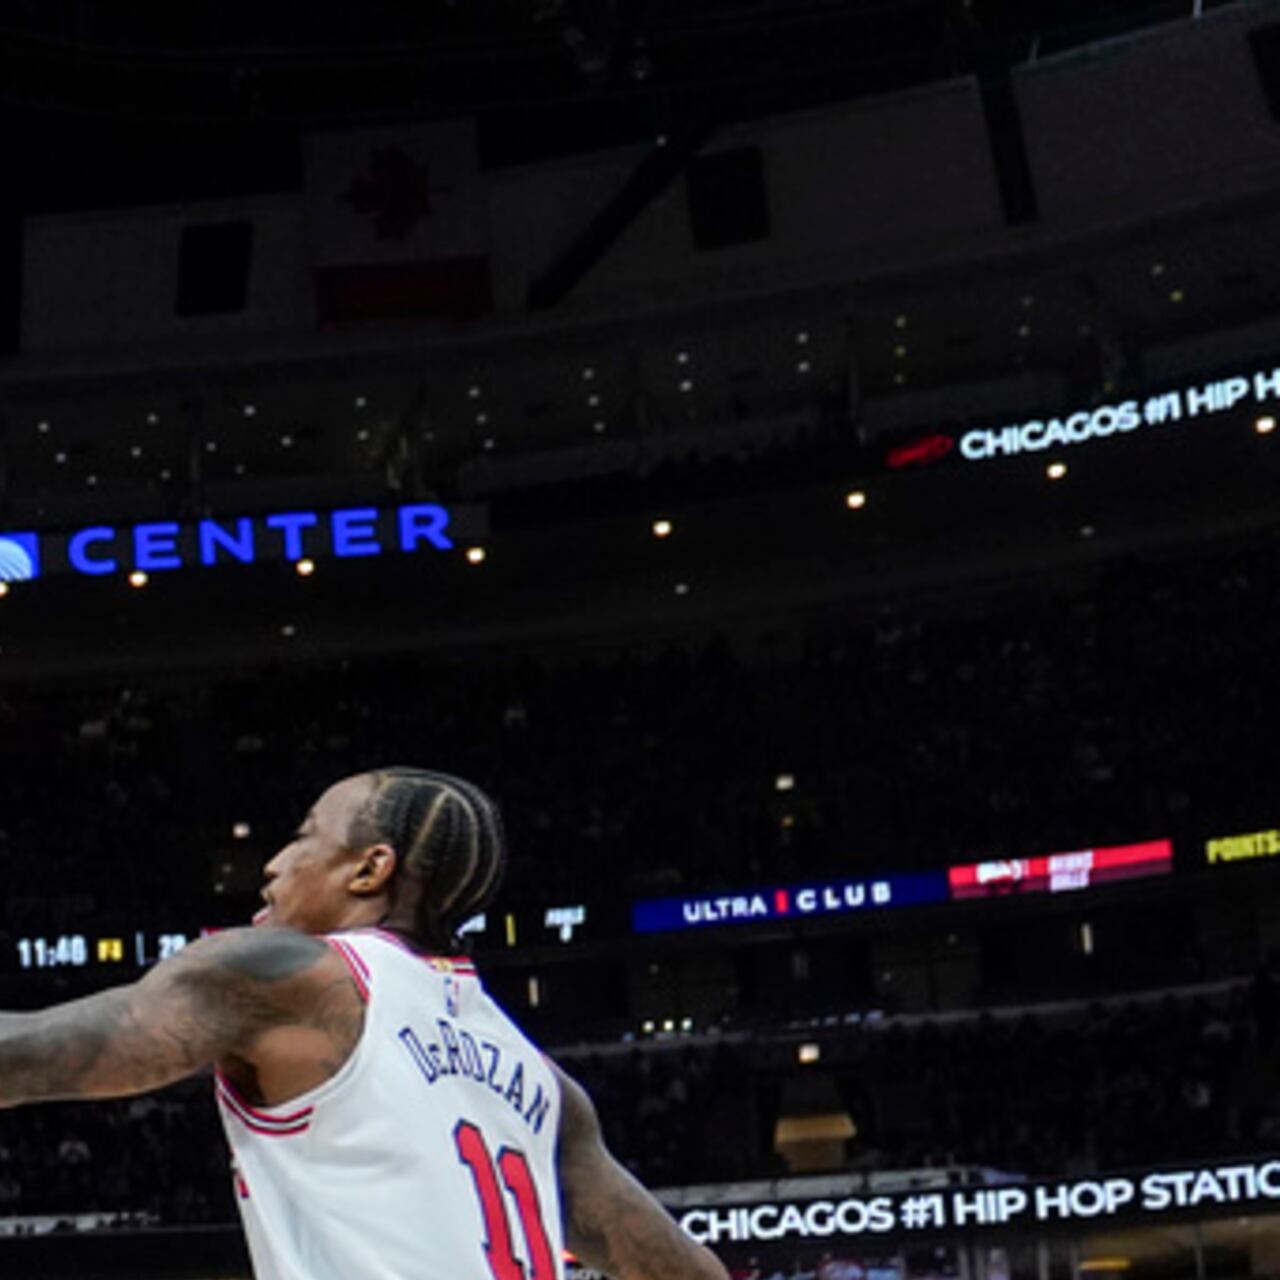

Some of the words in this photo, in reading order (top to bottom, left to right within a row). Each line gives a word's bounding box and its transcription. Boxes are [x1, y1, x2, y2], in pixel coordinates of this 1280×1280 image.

[959, 400, 1141, 460] CHICAGOS
[1143, 393, 1182, 425] #1
[1186, 377, 1251, 416] HIP
[67, 503, 453, 575] CENTER
[682, 896, 768, 923] ULTRA
[796, 881, 891, 911] CLUB
[681, 1198, 895, 1244] CHICAGOS
[900, 1194, 945, 1228] #1
[953, 1189, 1027, 1225] HIP
[1036, 1179, 1134, 1218] HOP
